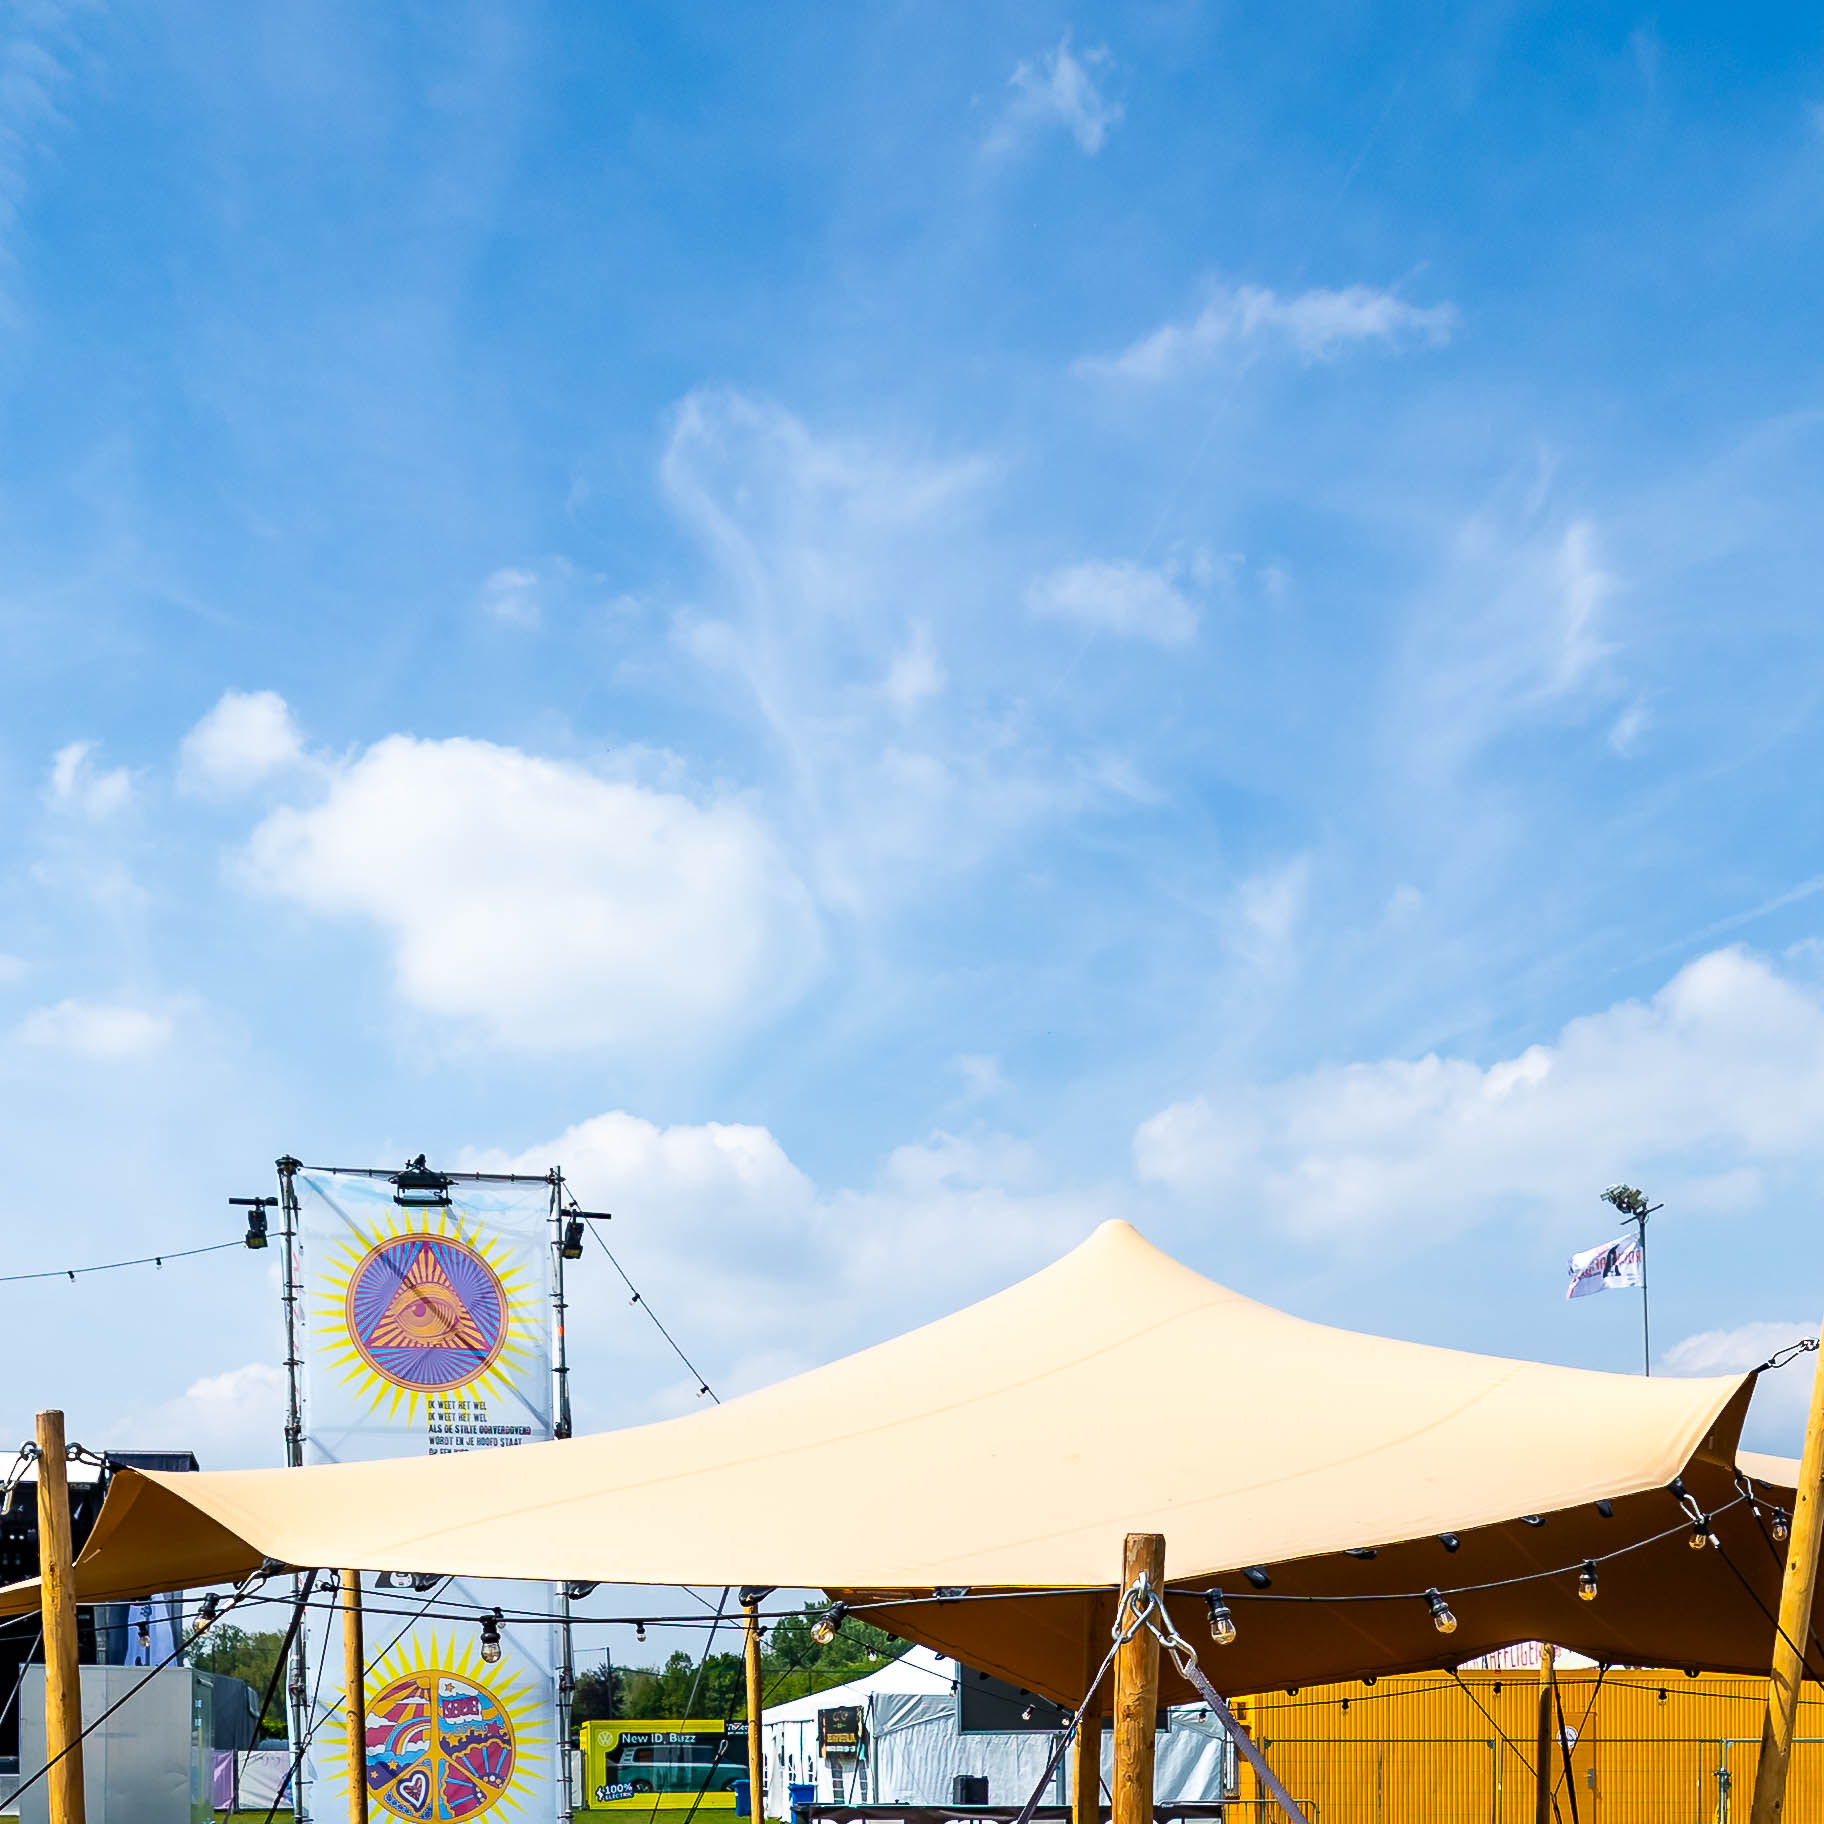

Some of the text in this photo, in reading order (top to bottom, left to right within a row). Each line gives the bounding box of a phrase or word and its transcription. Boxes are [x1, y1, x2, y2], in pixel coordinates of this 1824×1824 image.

[428, 1424, 442, 1433] ALS
[622, 1733, 648, 1743] New
[669, 1733, 696, 1743] Buzz
